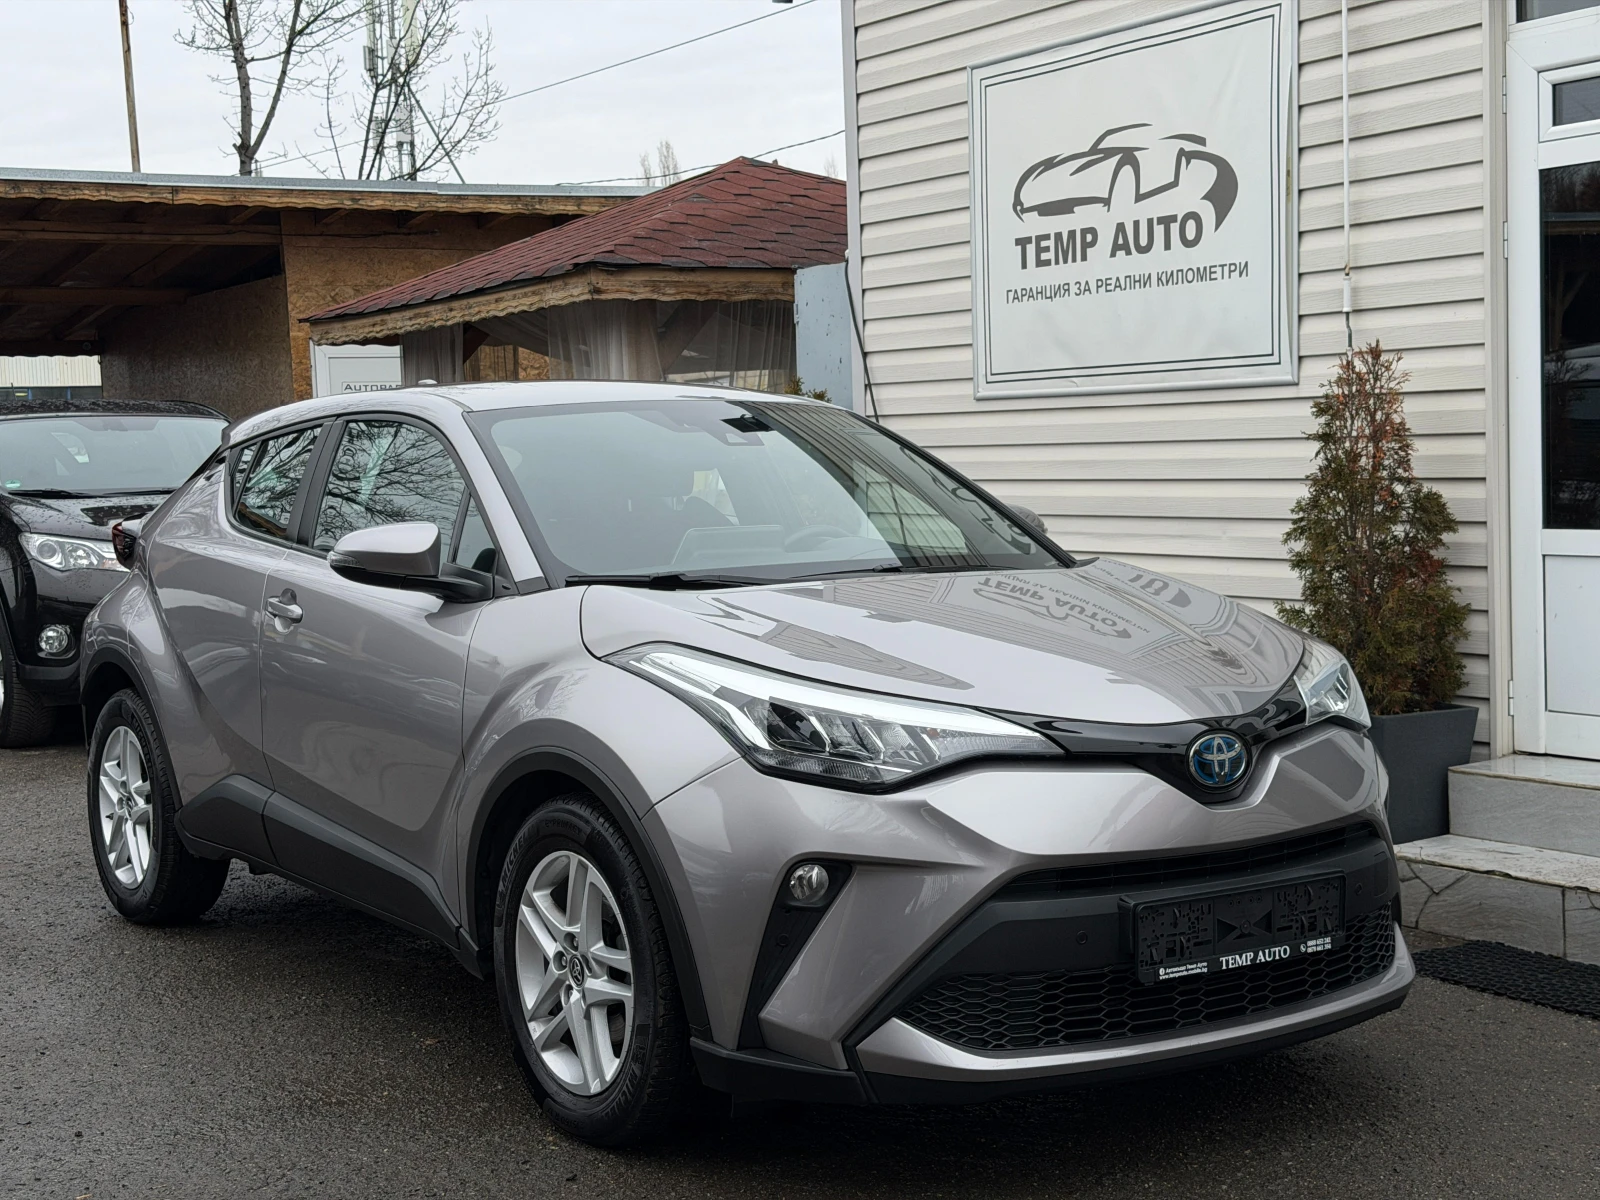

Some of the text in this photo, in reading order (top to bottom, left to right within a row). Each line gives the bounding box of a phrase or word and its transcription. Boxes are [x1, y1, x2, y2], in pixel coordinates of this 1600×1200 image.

[1014, 210, 1204, 270] TEMP AUTO
[1006, 260, 1249, 304] ГАРАНЦИЯ ЗА РЕАЛНИ КИЛОМЕТРИ
[1220, 946, 1290, 969] TEMP AUTO
